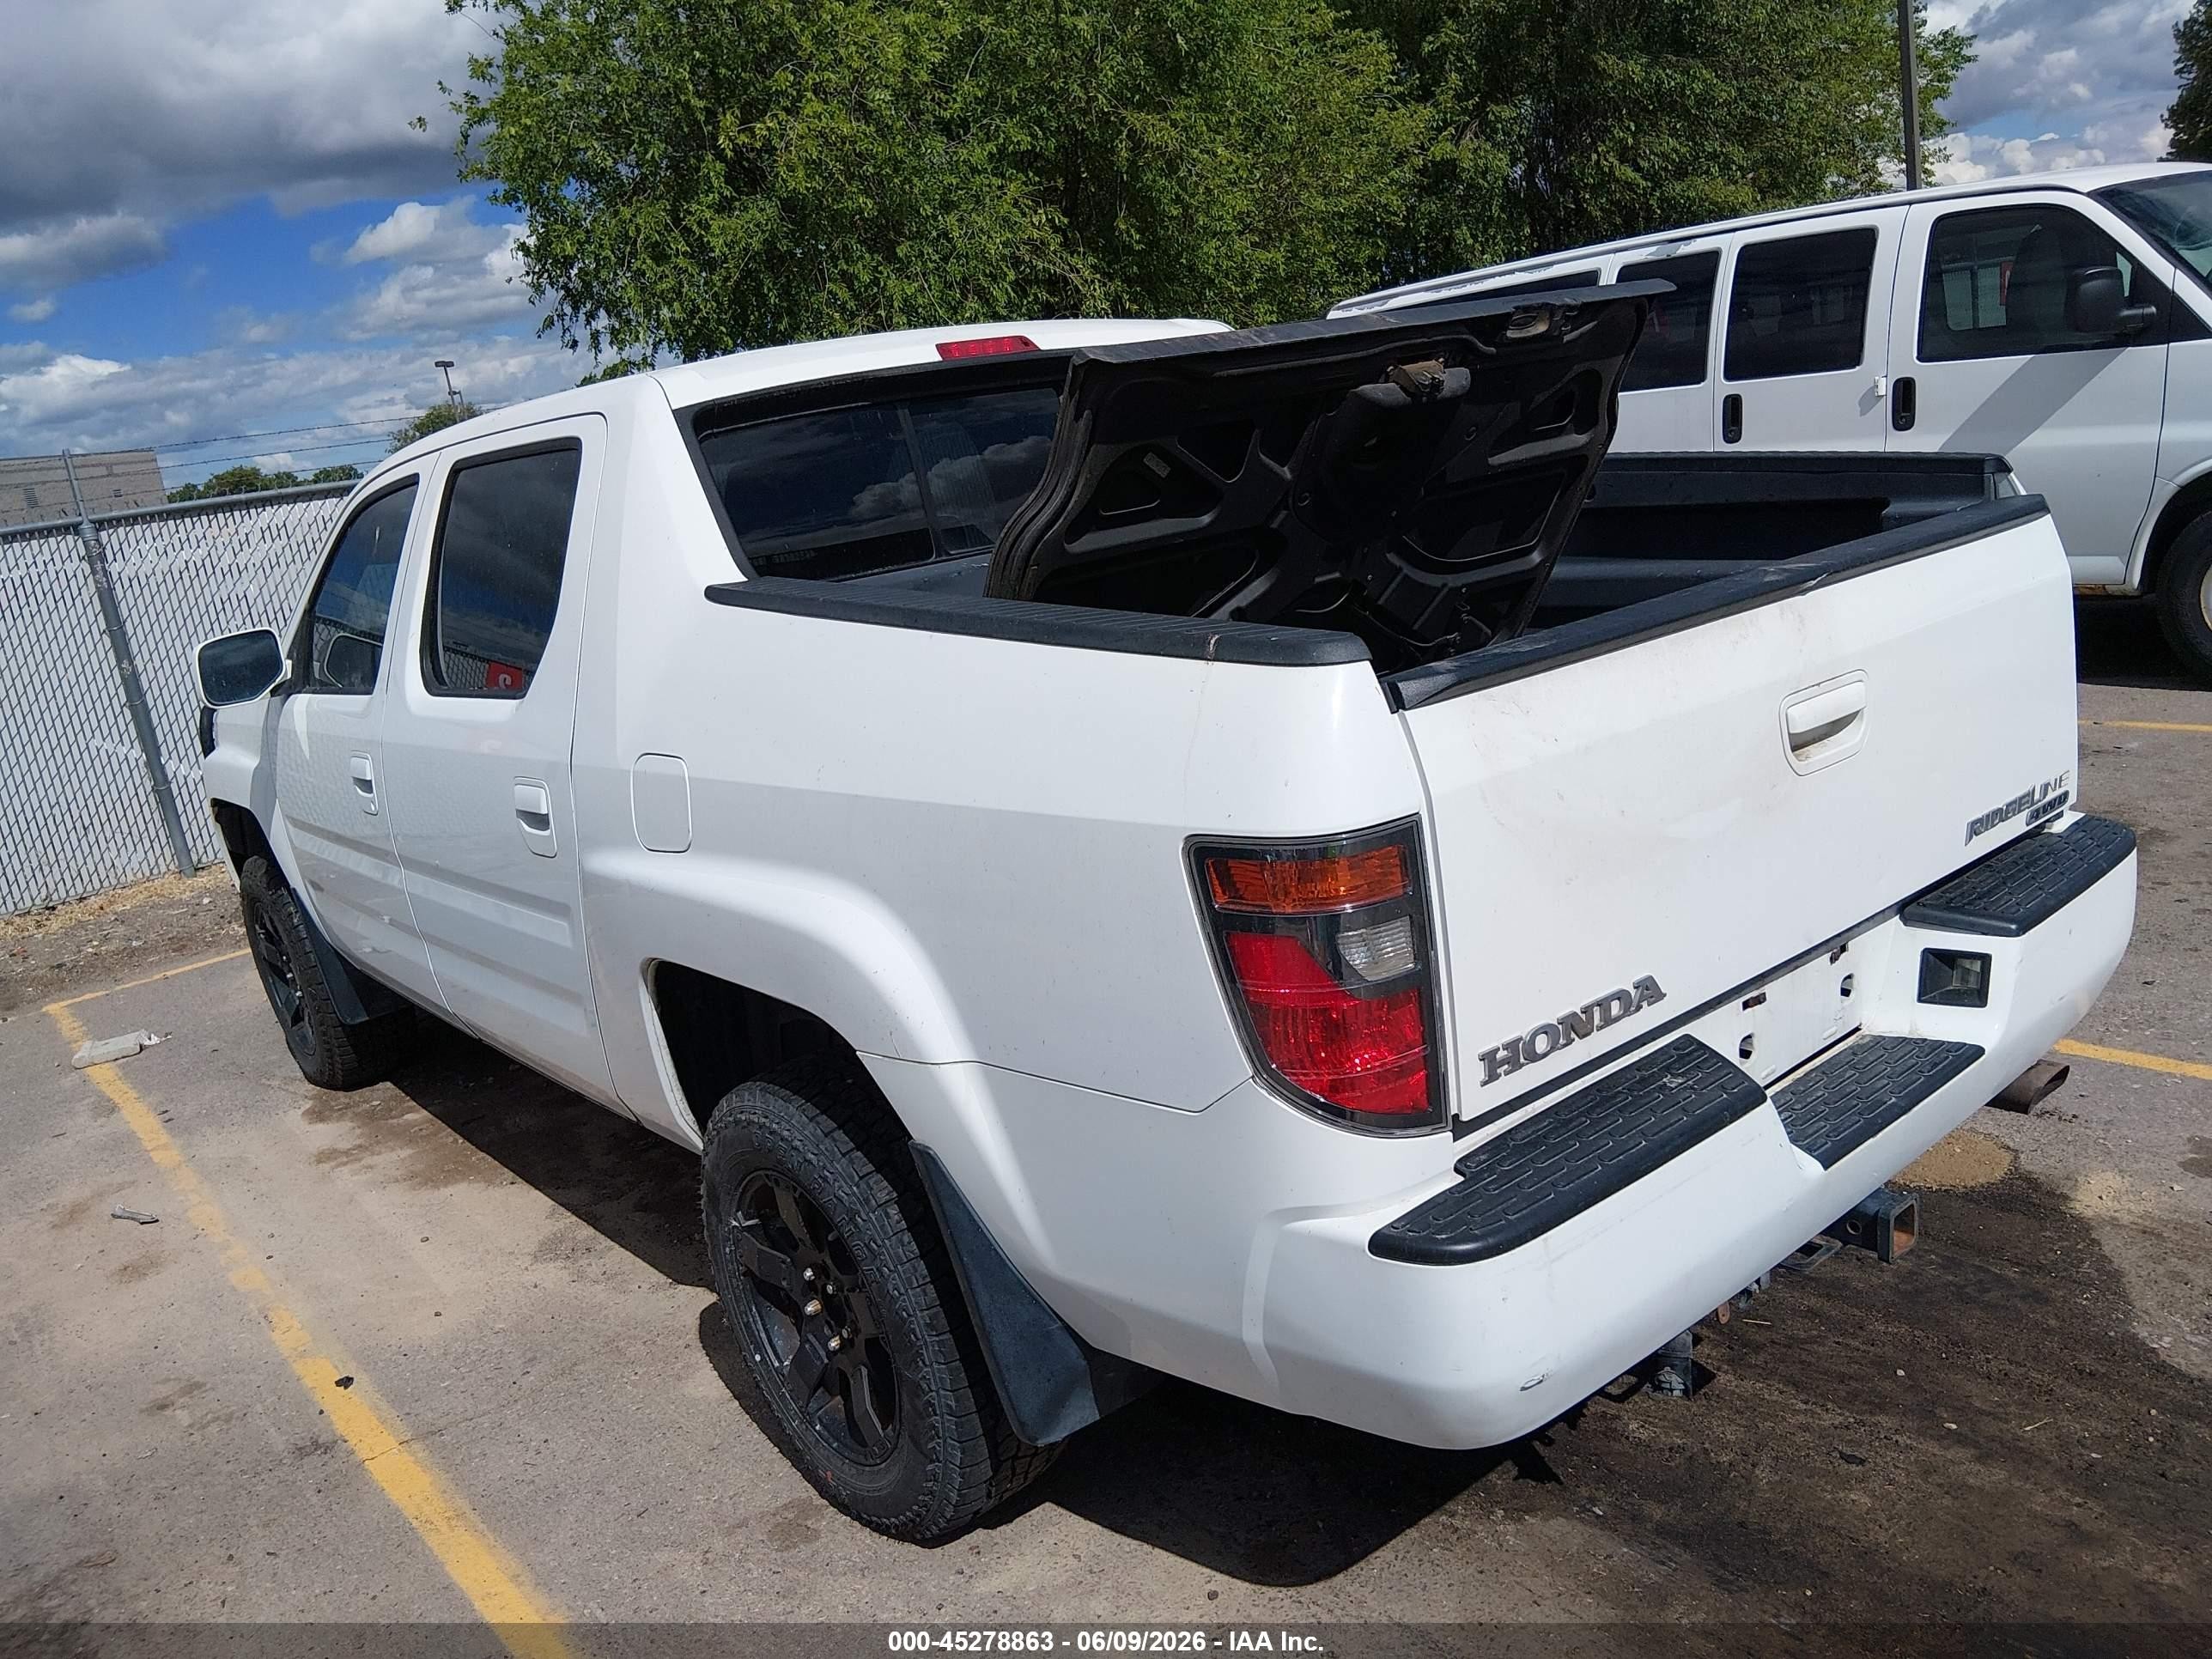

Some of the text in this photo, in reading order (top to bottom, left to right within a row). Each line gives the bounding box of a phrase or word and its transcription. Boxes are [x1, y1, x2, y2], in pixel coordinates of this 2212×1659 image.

[1965, 769, 2070, 847] RIDGELINE
[2027, 791, 2069, 824] 4WD
[1478, 974, 1668, 1087] HONDA
